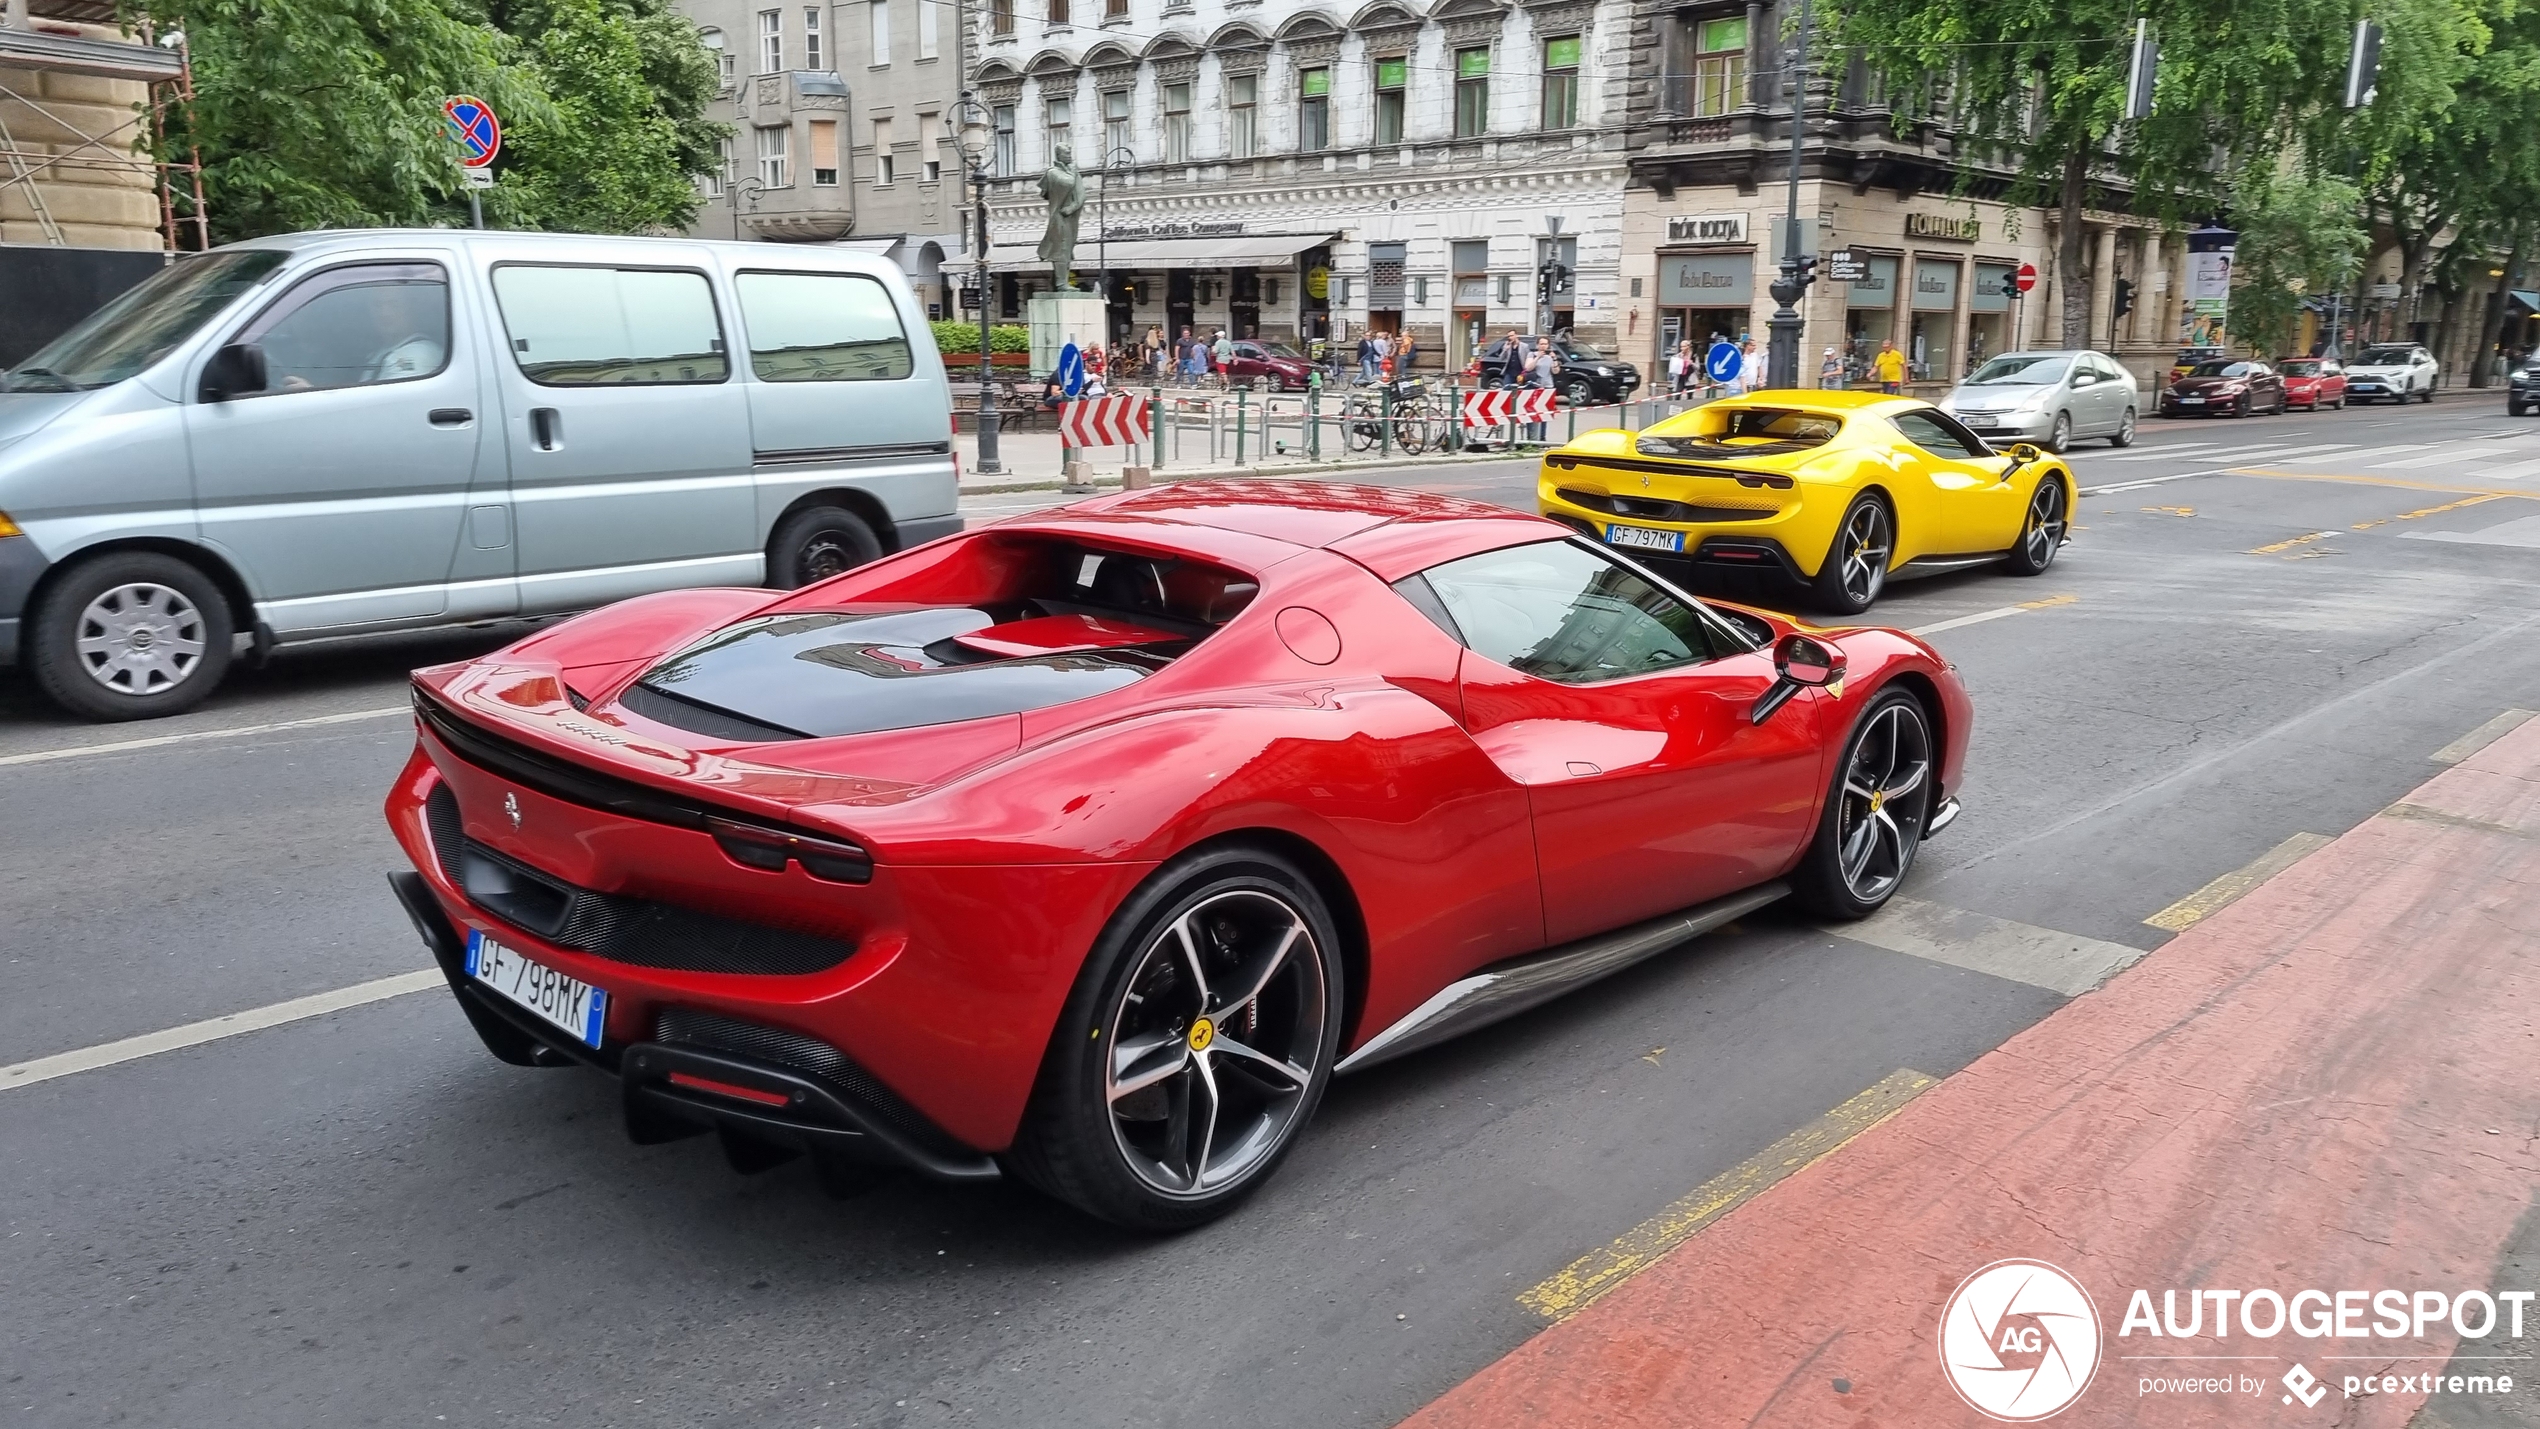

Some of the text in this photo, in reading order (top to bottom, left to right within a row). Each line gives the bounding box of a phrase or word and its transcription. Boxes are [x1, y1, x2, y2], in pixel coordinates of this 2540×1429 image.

[1152, 224, 1188, 235] Coffee
[1191, 221, 1243, 234] Company
[1614, 527, 1675, 548] GF 797MK
[481, 935, 587, 1032] GF 798MK
